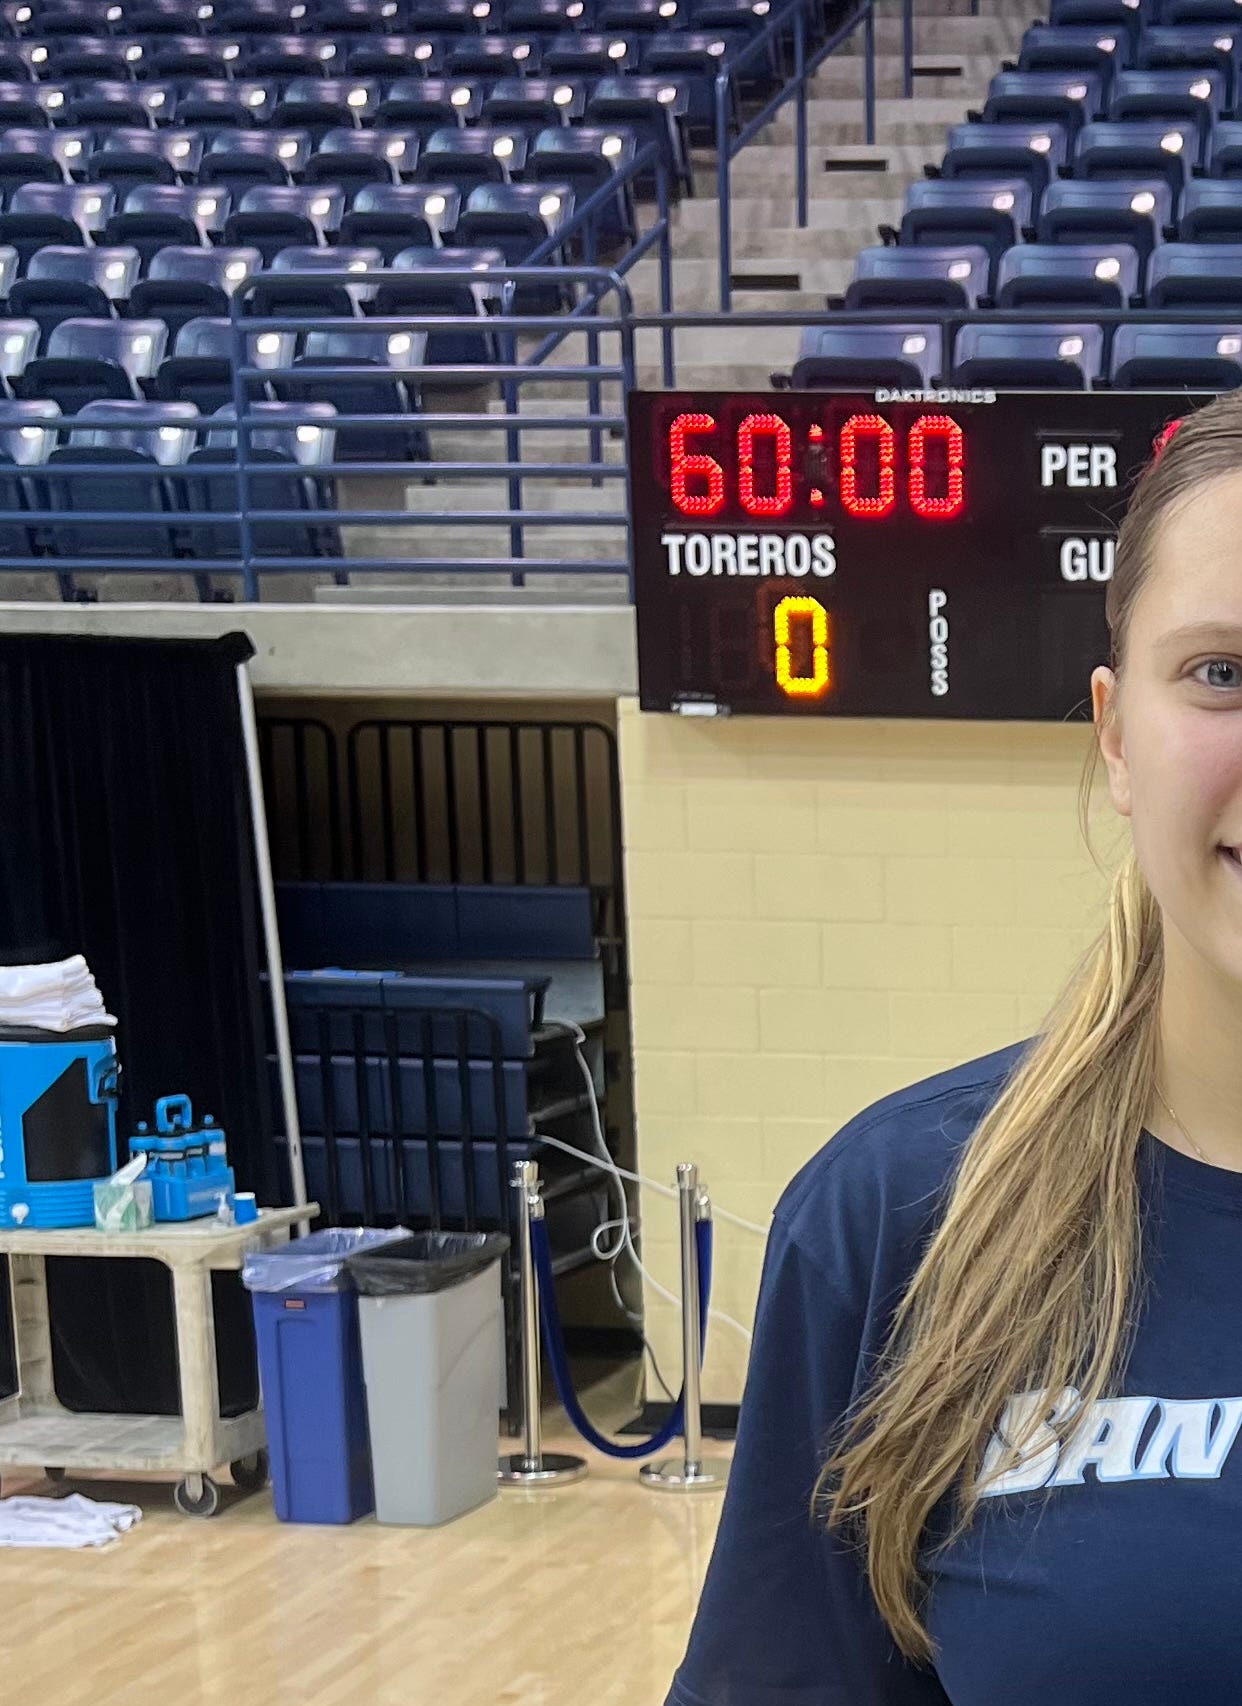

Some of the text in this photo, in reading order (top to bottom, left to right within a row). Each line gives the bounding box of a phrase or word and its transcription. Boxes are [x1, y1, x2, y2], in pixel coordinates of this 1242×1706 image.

[875, 387, 997, 403] DAKTRONICS
[669, 413, 967, 517] 60:00
[1040, 444, 1118, 488] PER
[661, 534, 837, 577] TOREROS
[774, 596, 830, 696] 0
[928, 588, 949, 697] POSS
